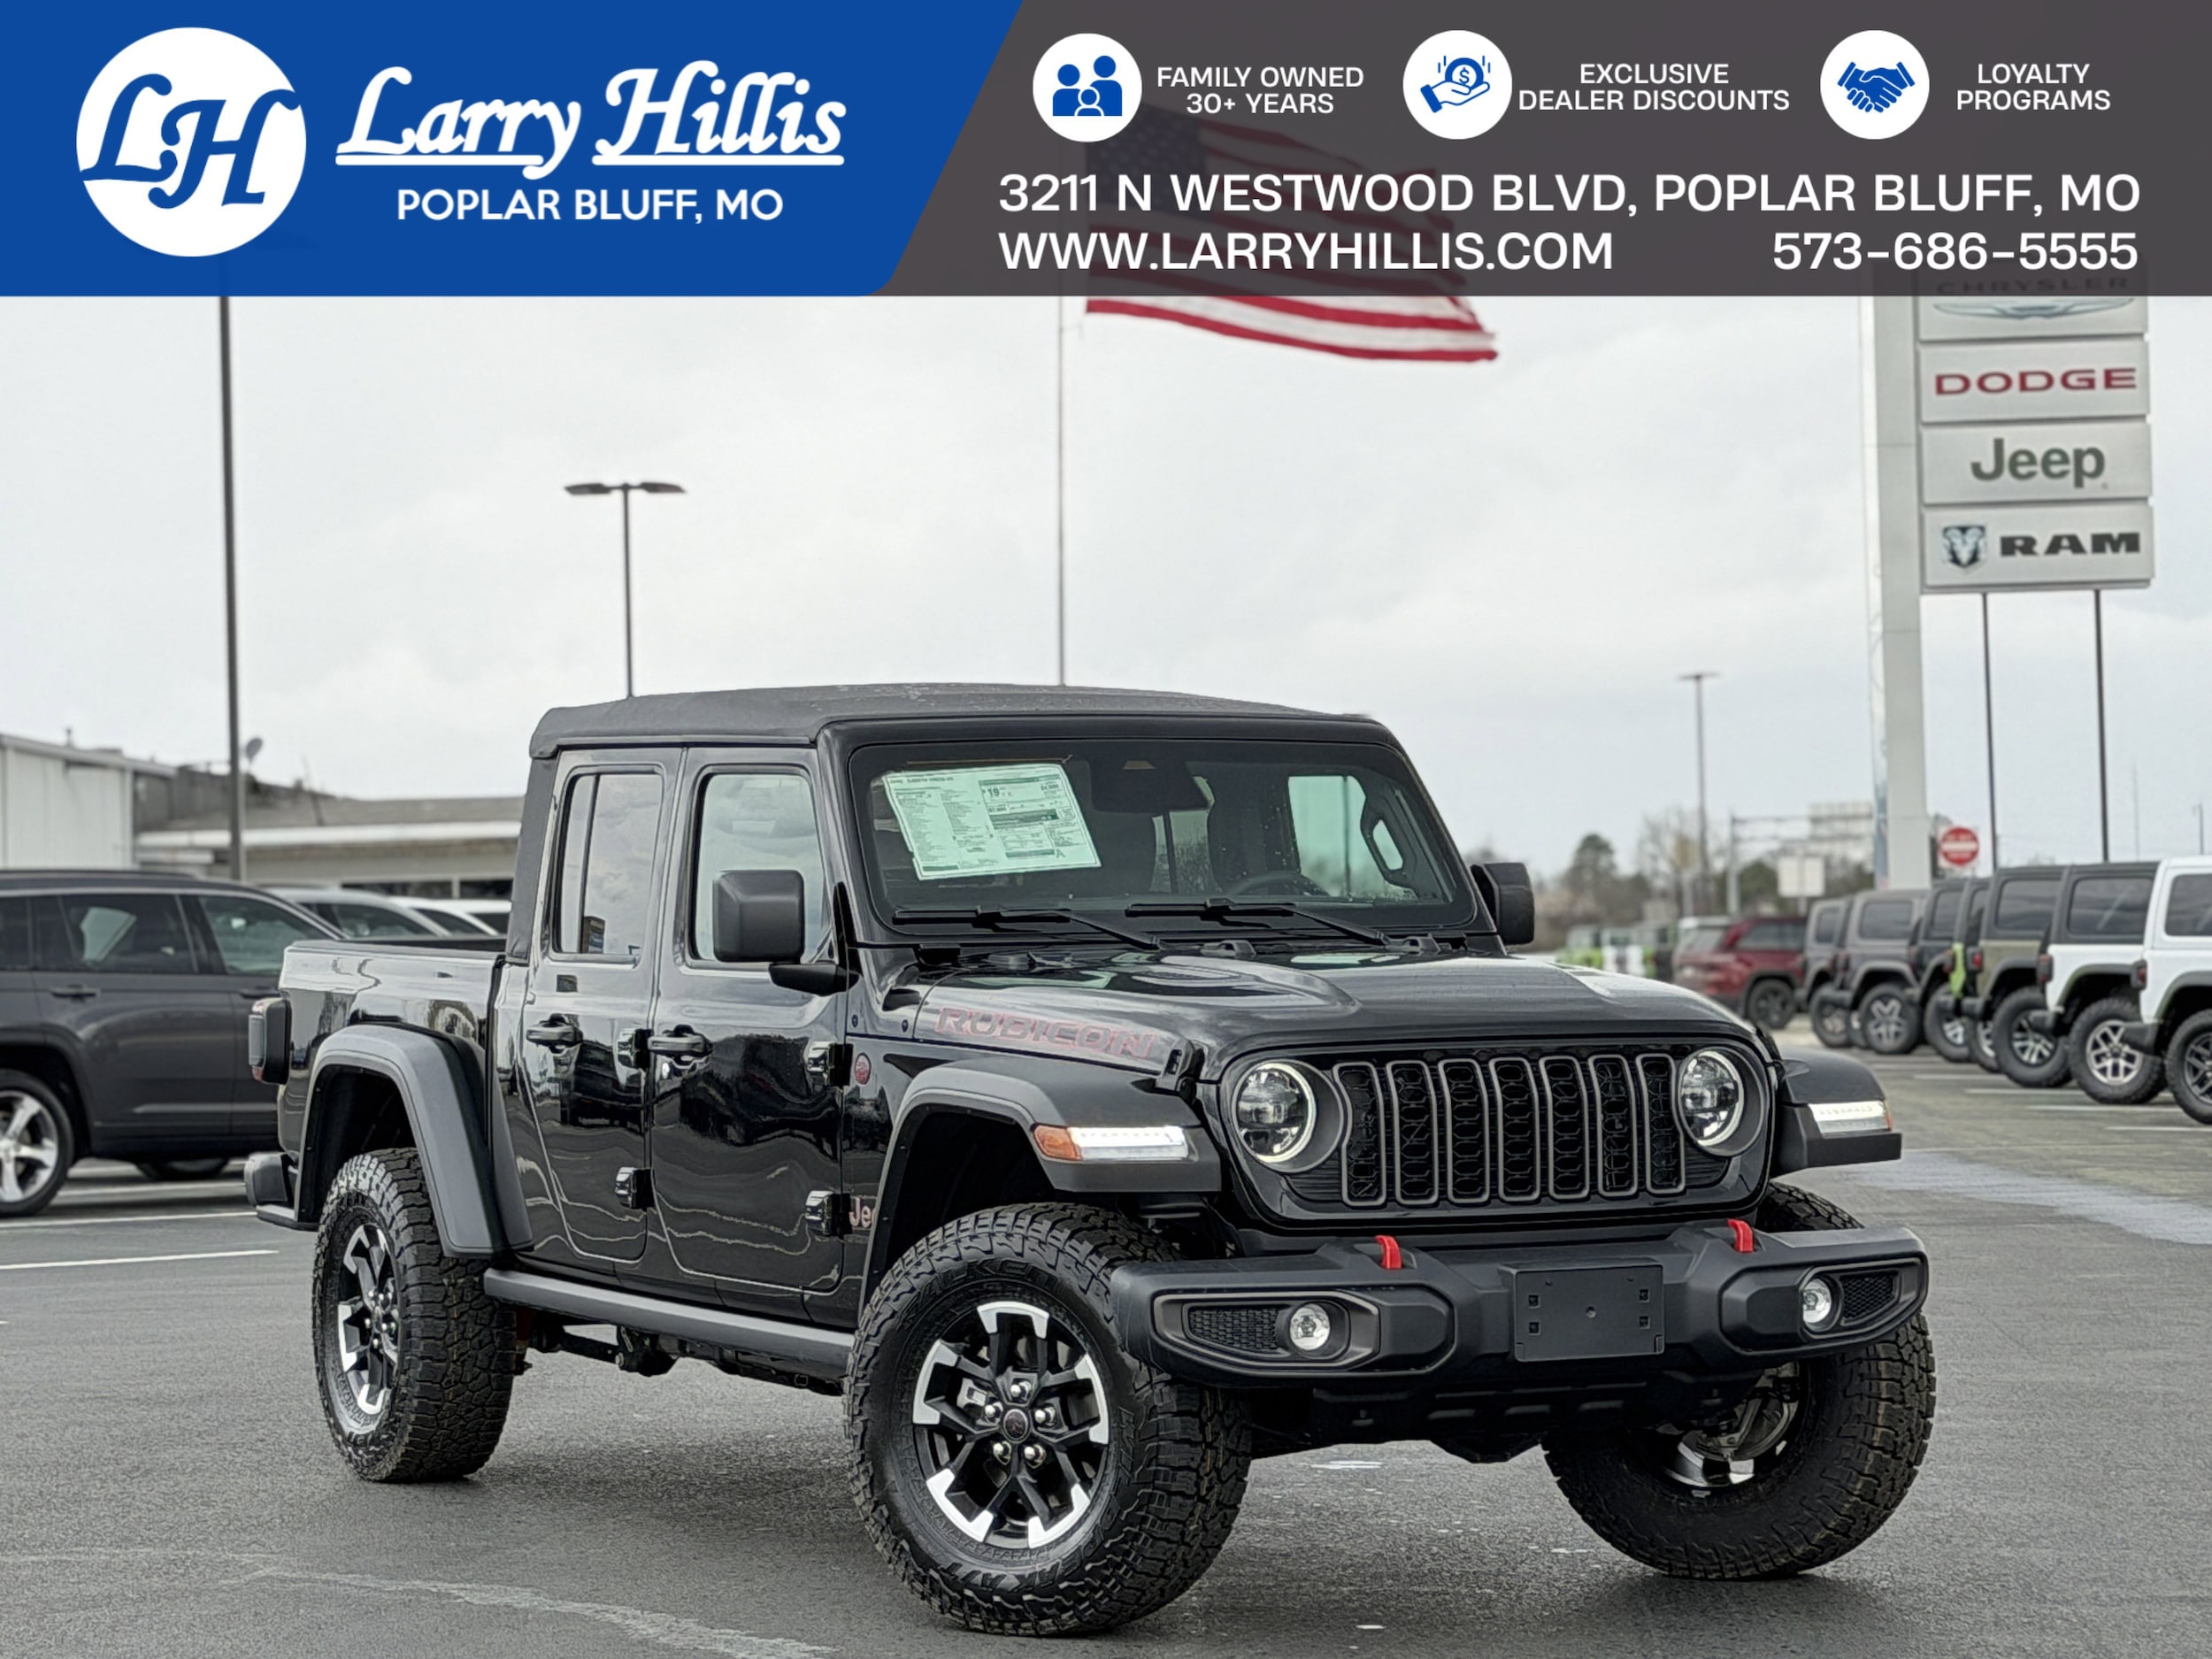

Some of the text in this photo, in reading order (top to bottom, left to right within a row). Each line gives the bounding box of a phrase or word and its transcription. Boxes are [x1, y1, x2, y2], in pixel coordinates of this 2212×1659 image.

[1938, 277, 2128, 295] CHRYSLER
[1933, 367, 2138, 396] DODGE
[1970, 437, 2107, 489] Jeep
[1999, 531, 2141, 558] RAM
[935, 1007, 1156, 1059] RUBICON
[849, 1196, 876, 1229] Je
